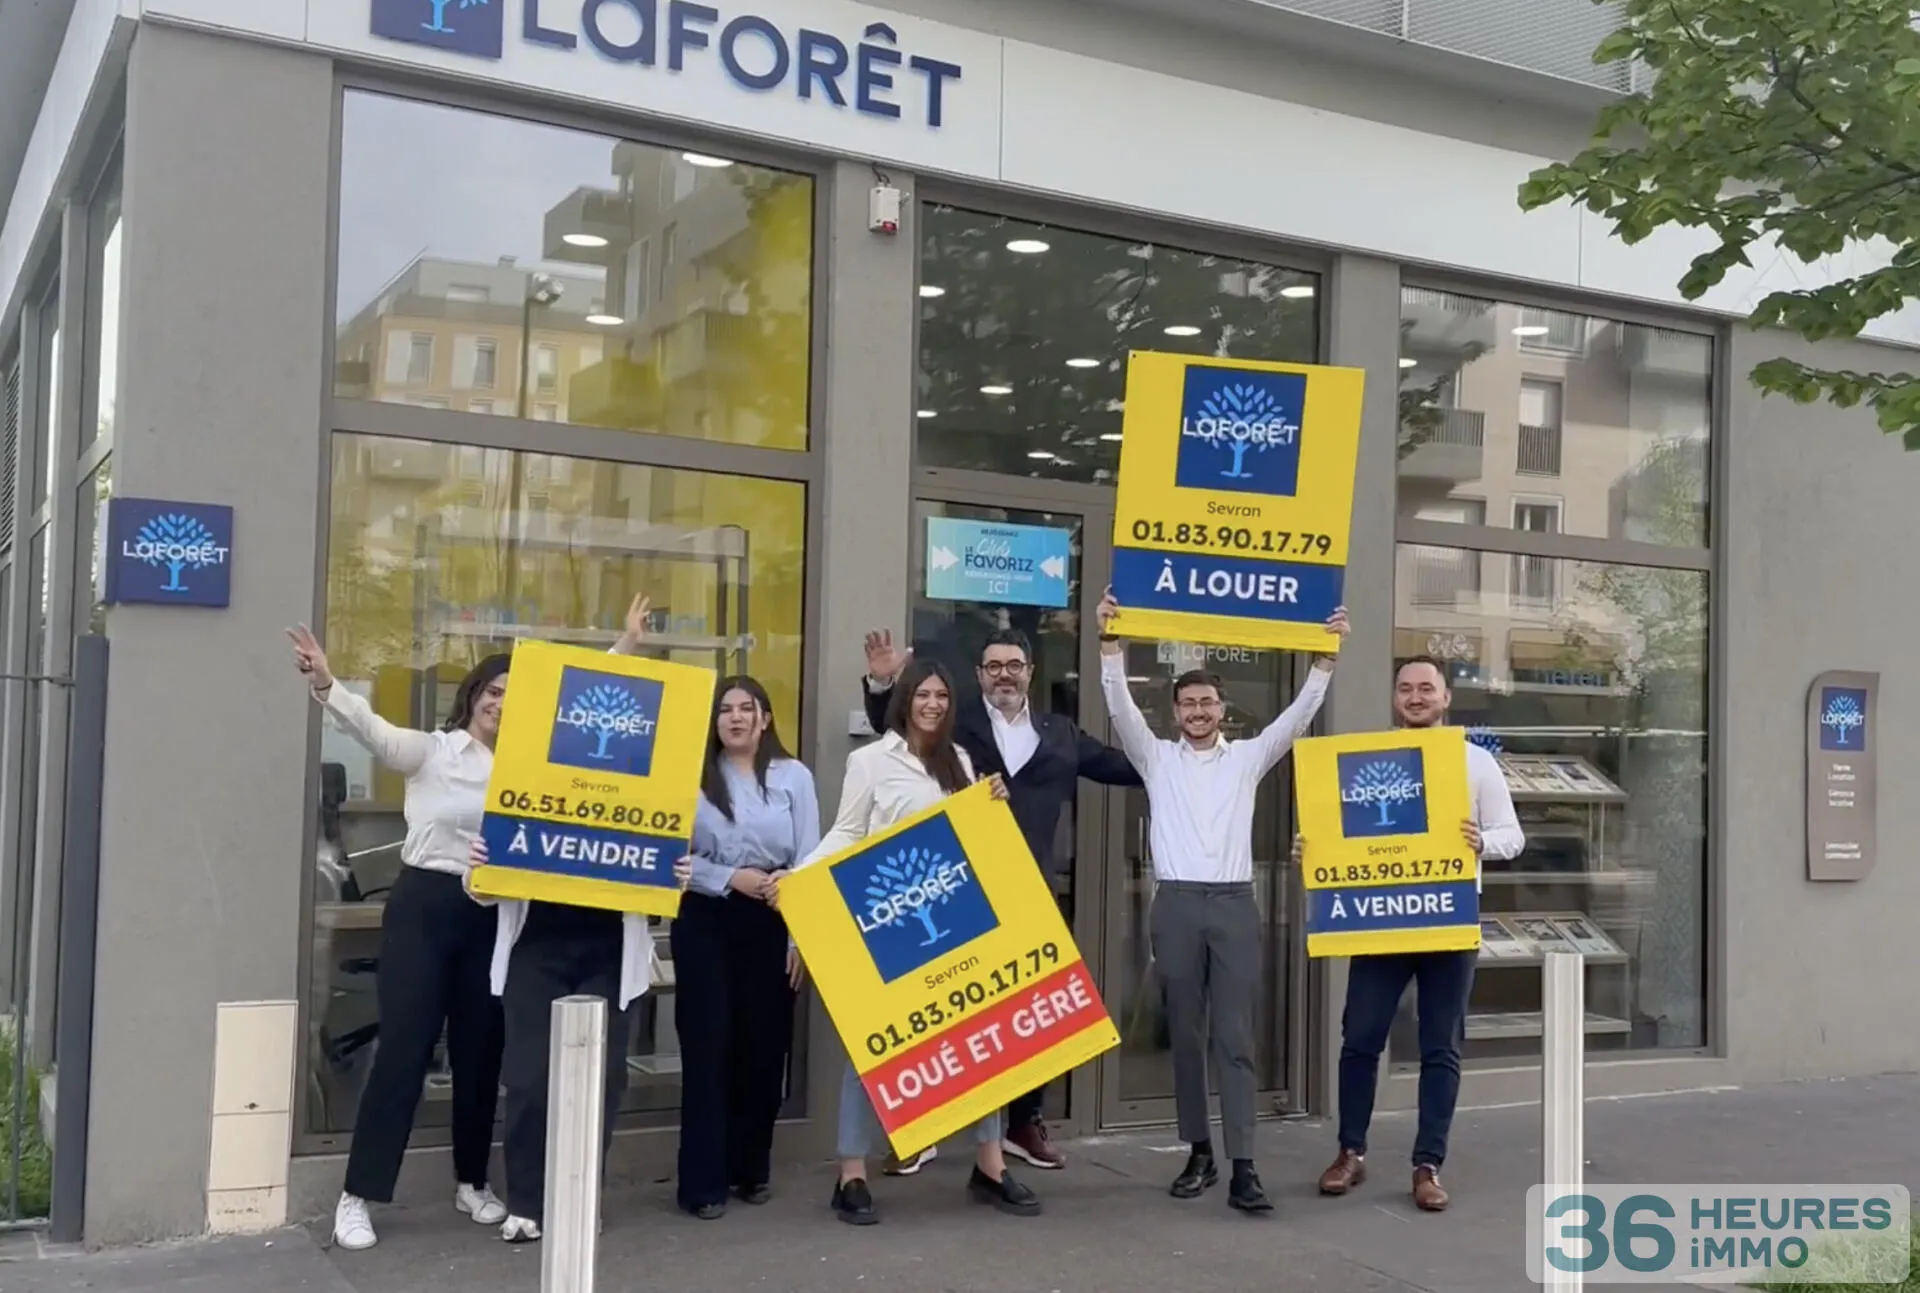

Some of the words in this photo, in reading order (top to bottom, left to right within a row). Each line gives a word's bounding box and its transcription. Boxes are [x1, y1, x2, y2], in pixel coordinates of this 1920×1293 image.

[1207, 501, 1261, 518] Sevran
[1132, 520, 1332, 556] 01.83.90.17.79
[987, 579, 1010, 595] ICI
[1155, 558, 1177, 593] À
[1188, 568, 1299, 603] LOUER
[571, 777, 620, 794] Sevran
[499, 789, 681, 831] 06.51.69.80.02
[508, 824, 529, 854] À
[540, 832, 660, 870] VENDRE
[1367, 844, 1408, 856] Sevran
[1314, 858, 1464, 883] 01.83.90.17.79
[1330, 893, 1348, 919] À
[1353, 892, 1455, 918] VENDRE
[924, 953, 980, 990] Sevran
[865, 942, 1059, 1057] 01.83.90.17.79
[877, 1042, 965, 1111] LOUÉ
[965, 1023, 1005, 1064] ET
[1011, 973, 1092, 1038] GÉRÉ
